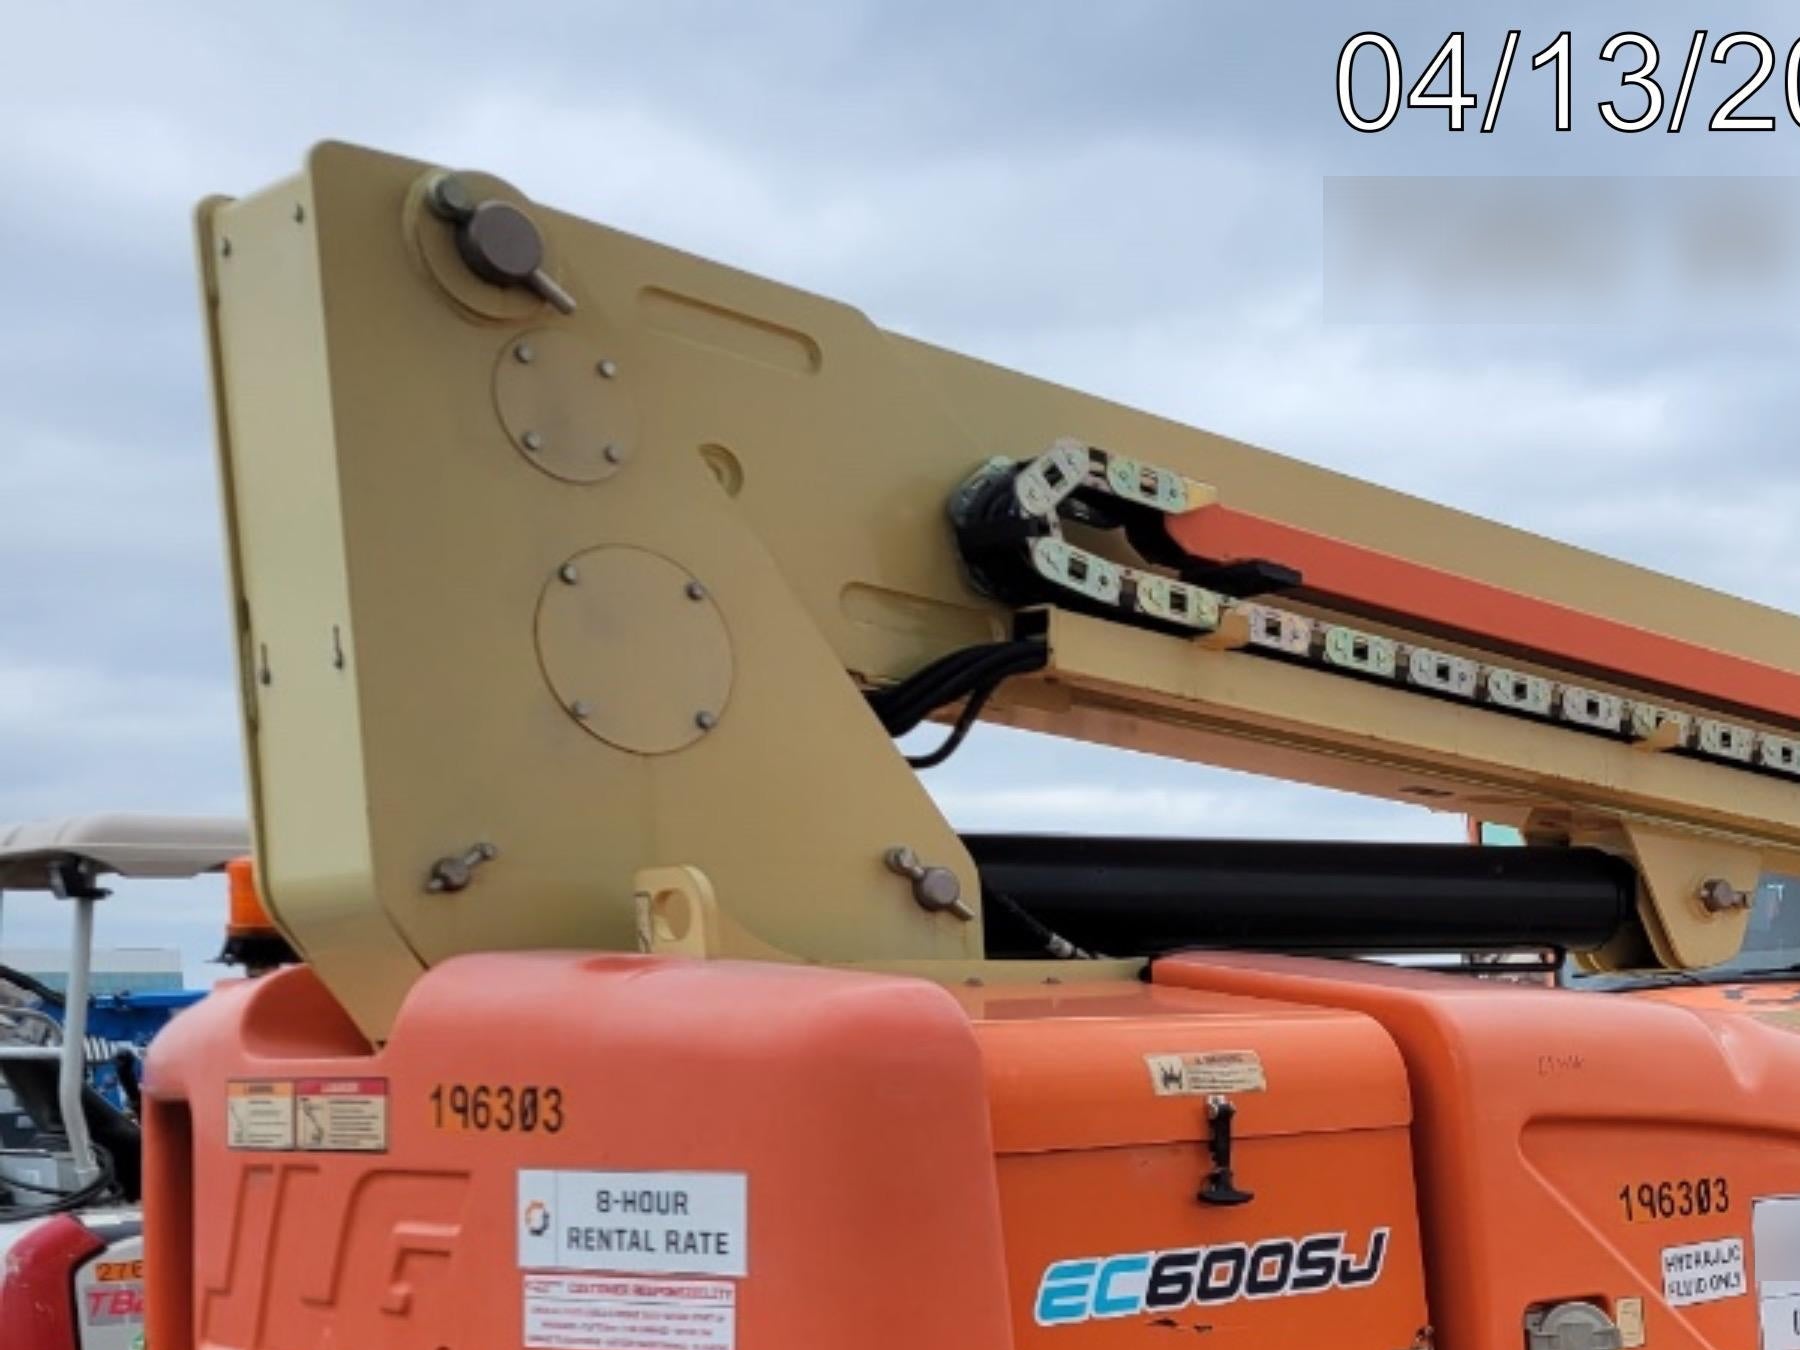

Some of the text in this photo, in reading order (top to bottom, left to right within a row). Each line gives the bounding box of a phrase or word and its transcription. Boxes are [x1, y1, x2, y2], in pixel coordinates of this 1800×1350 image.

[430, 1083, 565, 1132] 196303
[596, 1189, 690, 1216] 8-HOUR
[1618, 1176, 1729, 1221] 196303
[566, 1226, 730, 1256] RENTAL RATE
[1037, 1229, 1390, 1325] EC600SJ
